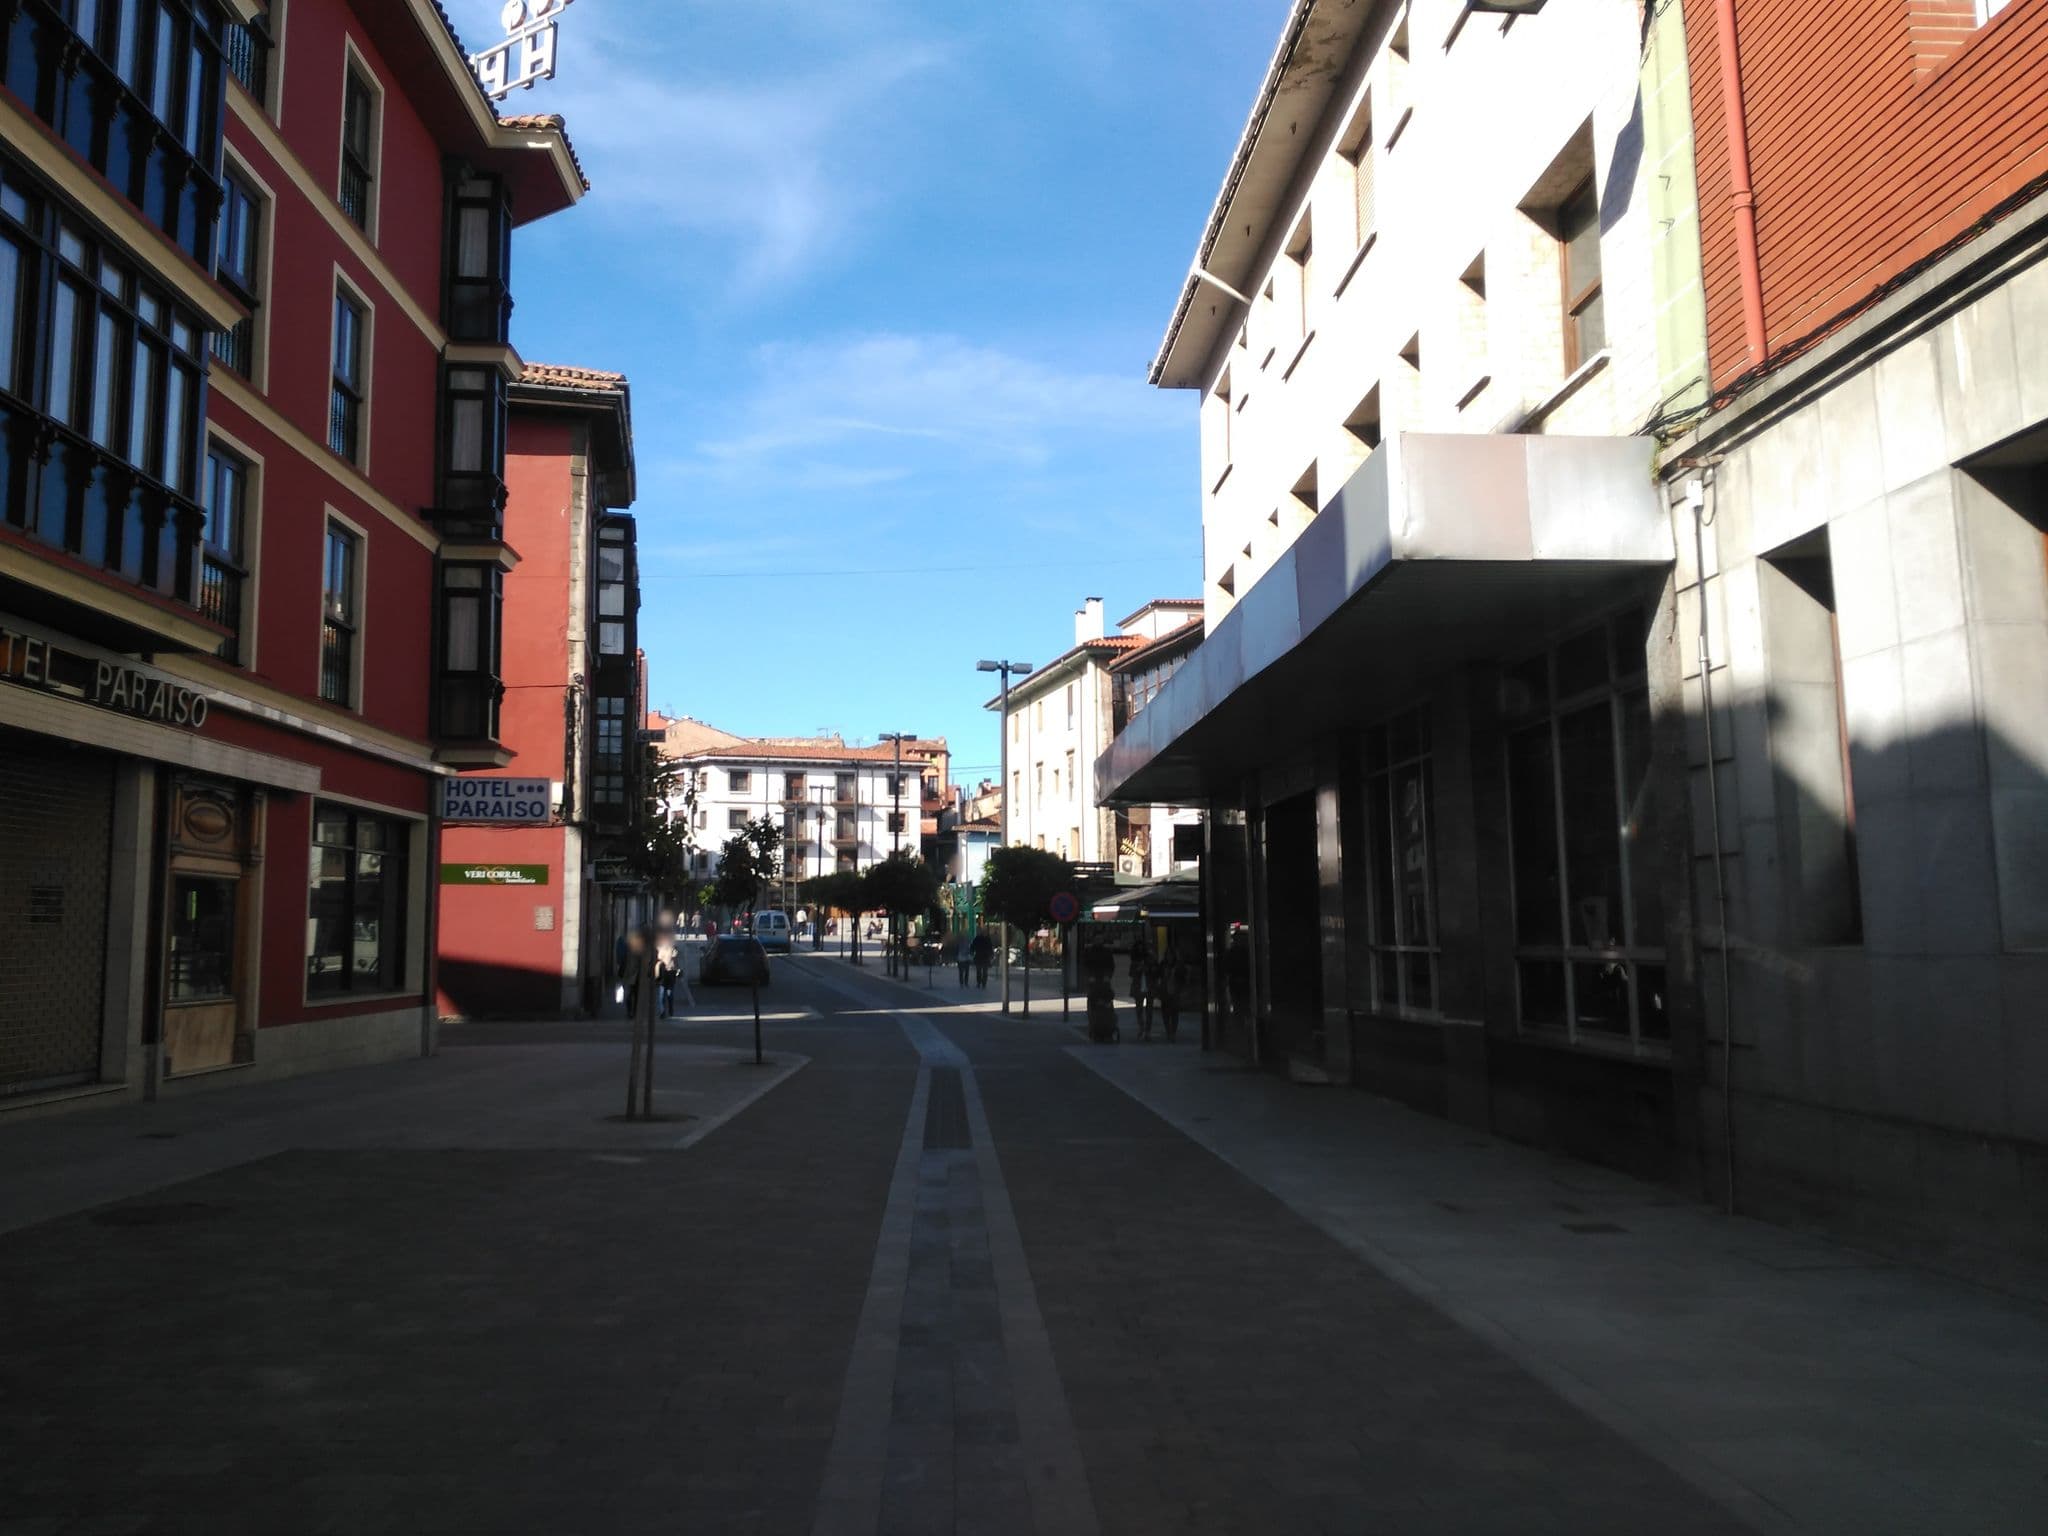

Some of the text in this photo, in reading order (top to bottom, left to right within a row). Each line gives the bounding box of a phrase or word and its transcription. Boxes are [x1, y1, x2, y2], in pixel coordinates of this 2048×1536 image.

[96, 660, 208, 728] PARAISO
[446, 780, 515, 797] HOTEL
[446, 801, 546, 818] PARAISO
